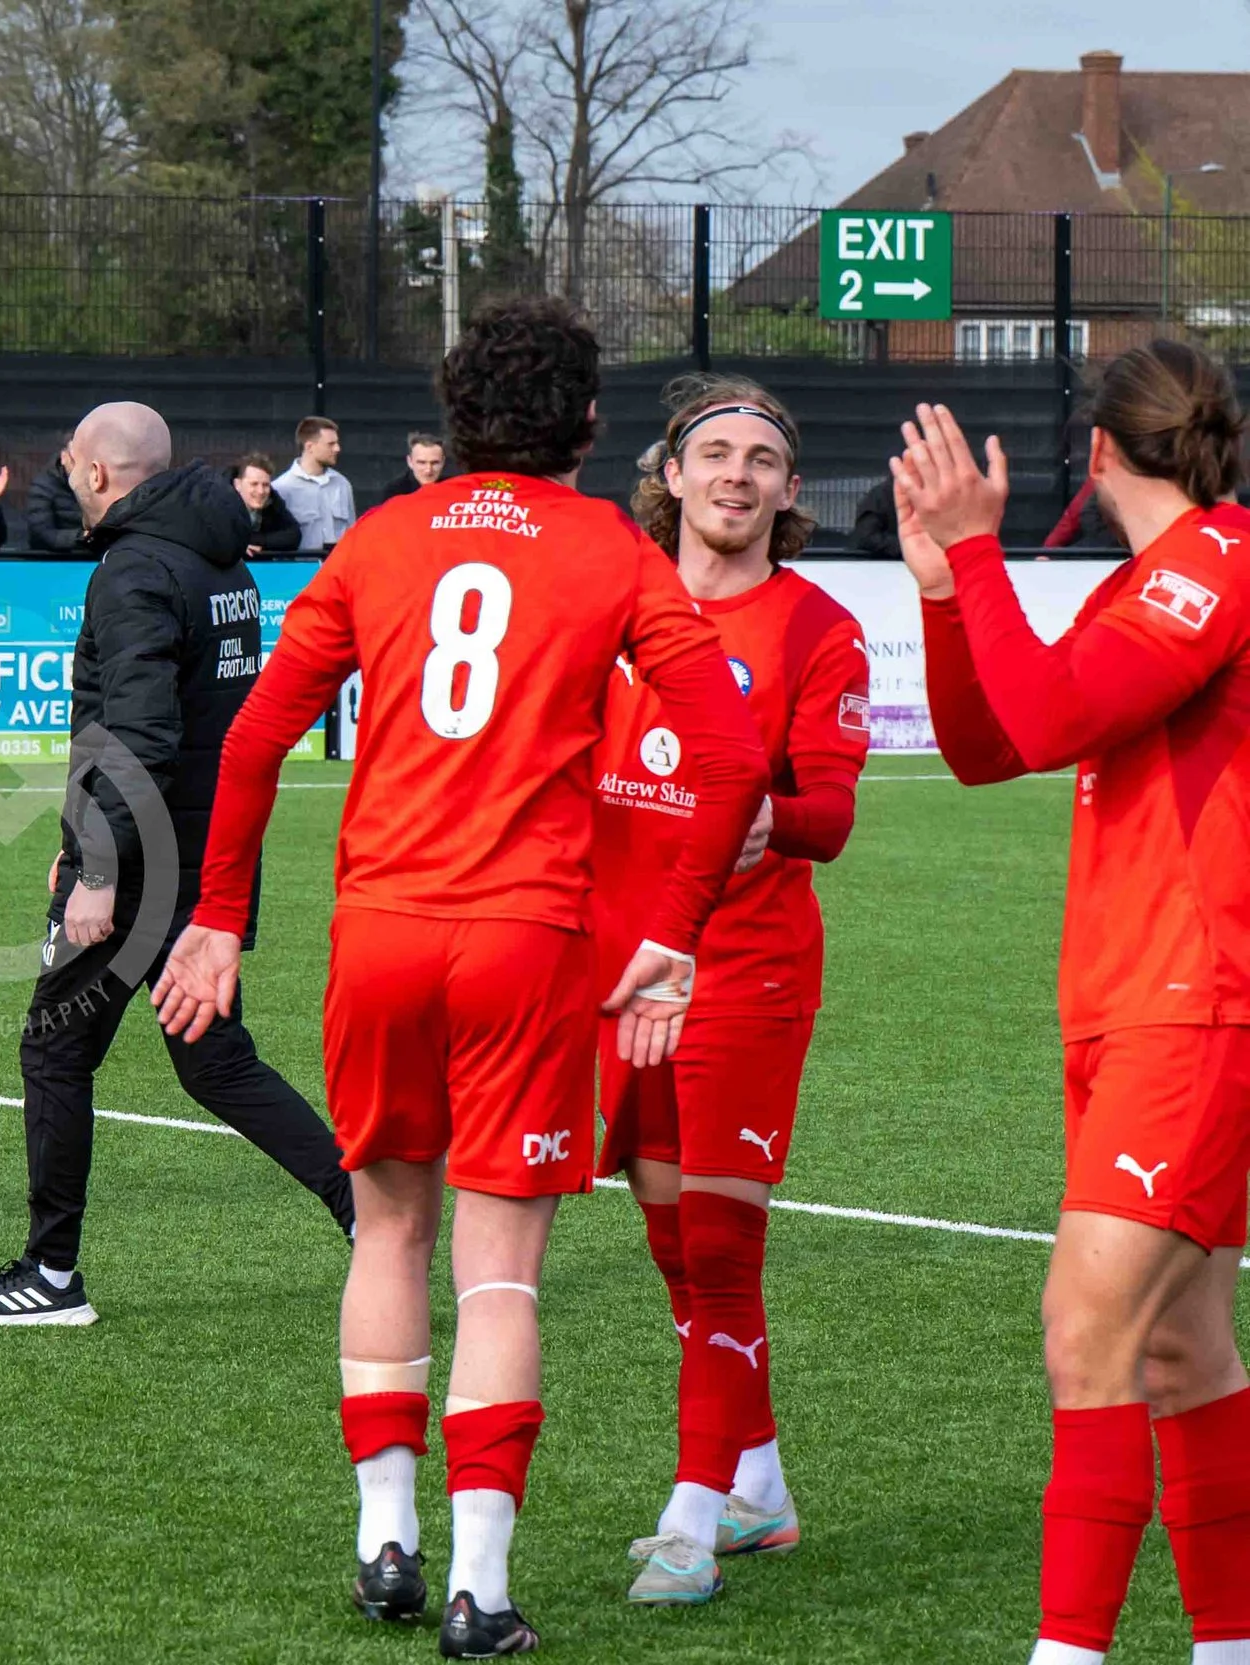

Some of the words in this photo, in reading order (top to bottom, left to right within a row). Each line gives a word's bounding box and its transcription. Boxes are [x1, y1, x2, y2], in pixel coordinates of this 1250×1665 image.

[839, 218, 934, 261] EXIT
[839, 270, 863, 310] 2
[471, 490, 514, 502] THE
[449, 502, 530, 521] CROWN
[431, 515, 542, 538] BILLERICAY
[421, 562, 512, 739] 8
[9, 700, 73, 726] AVE
